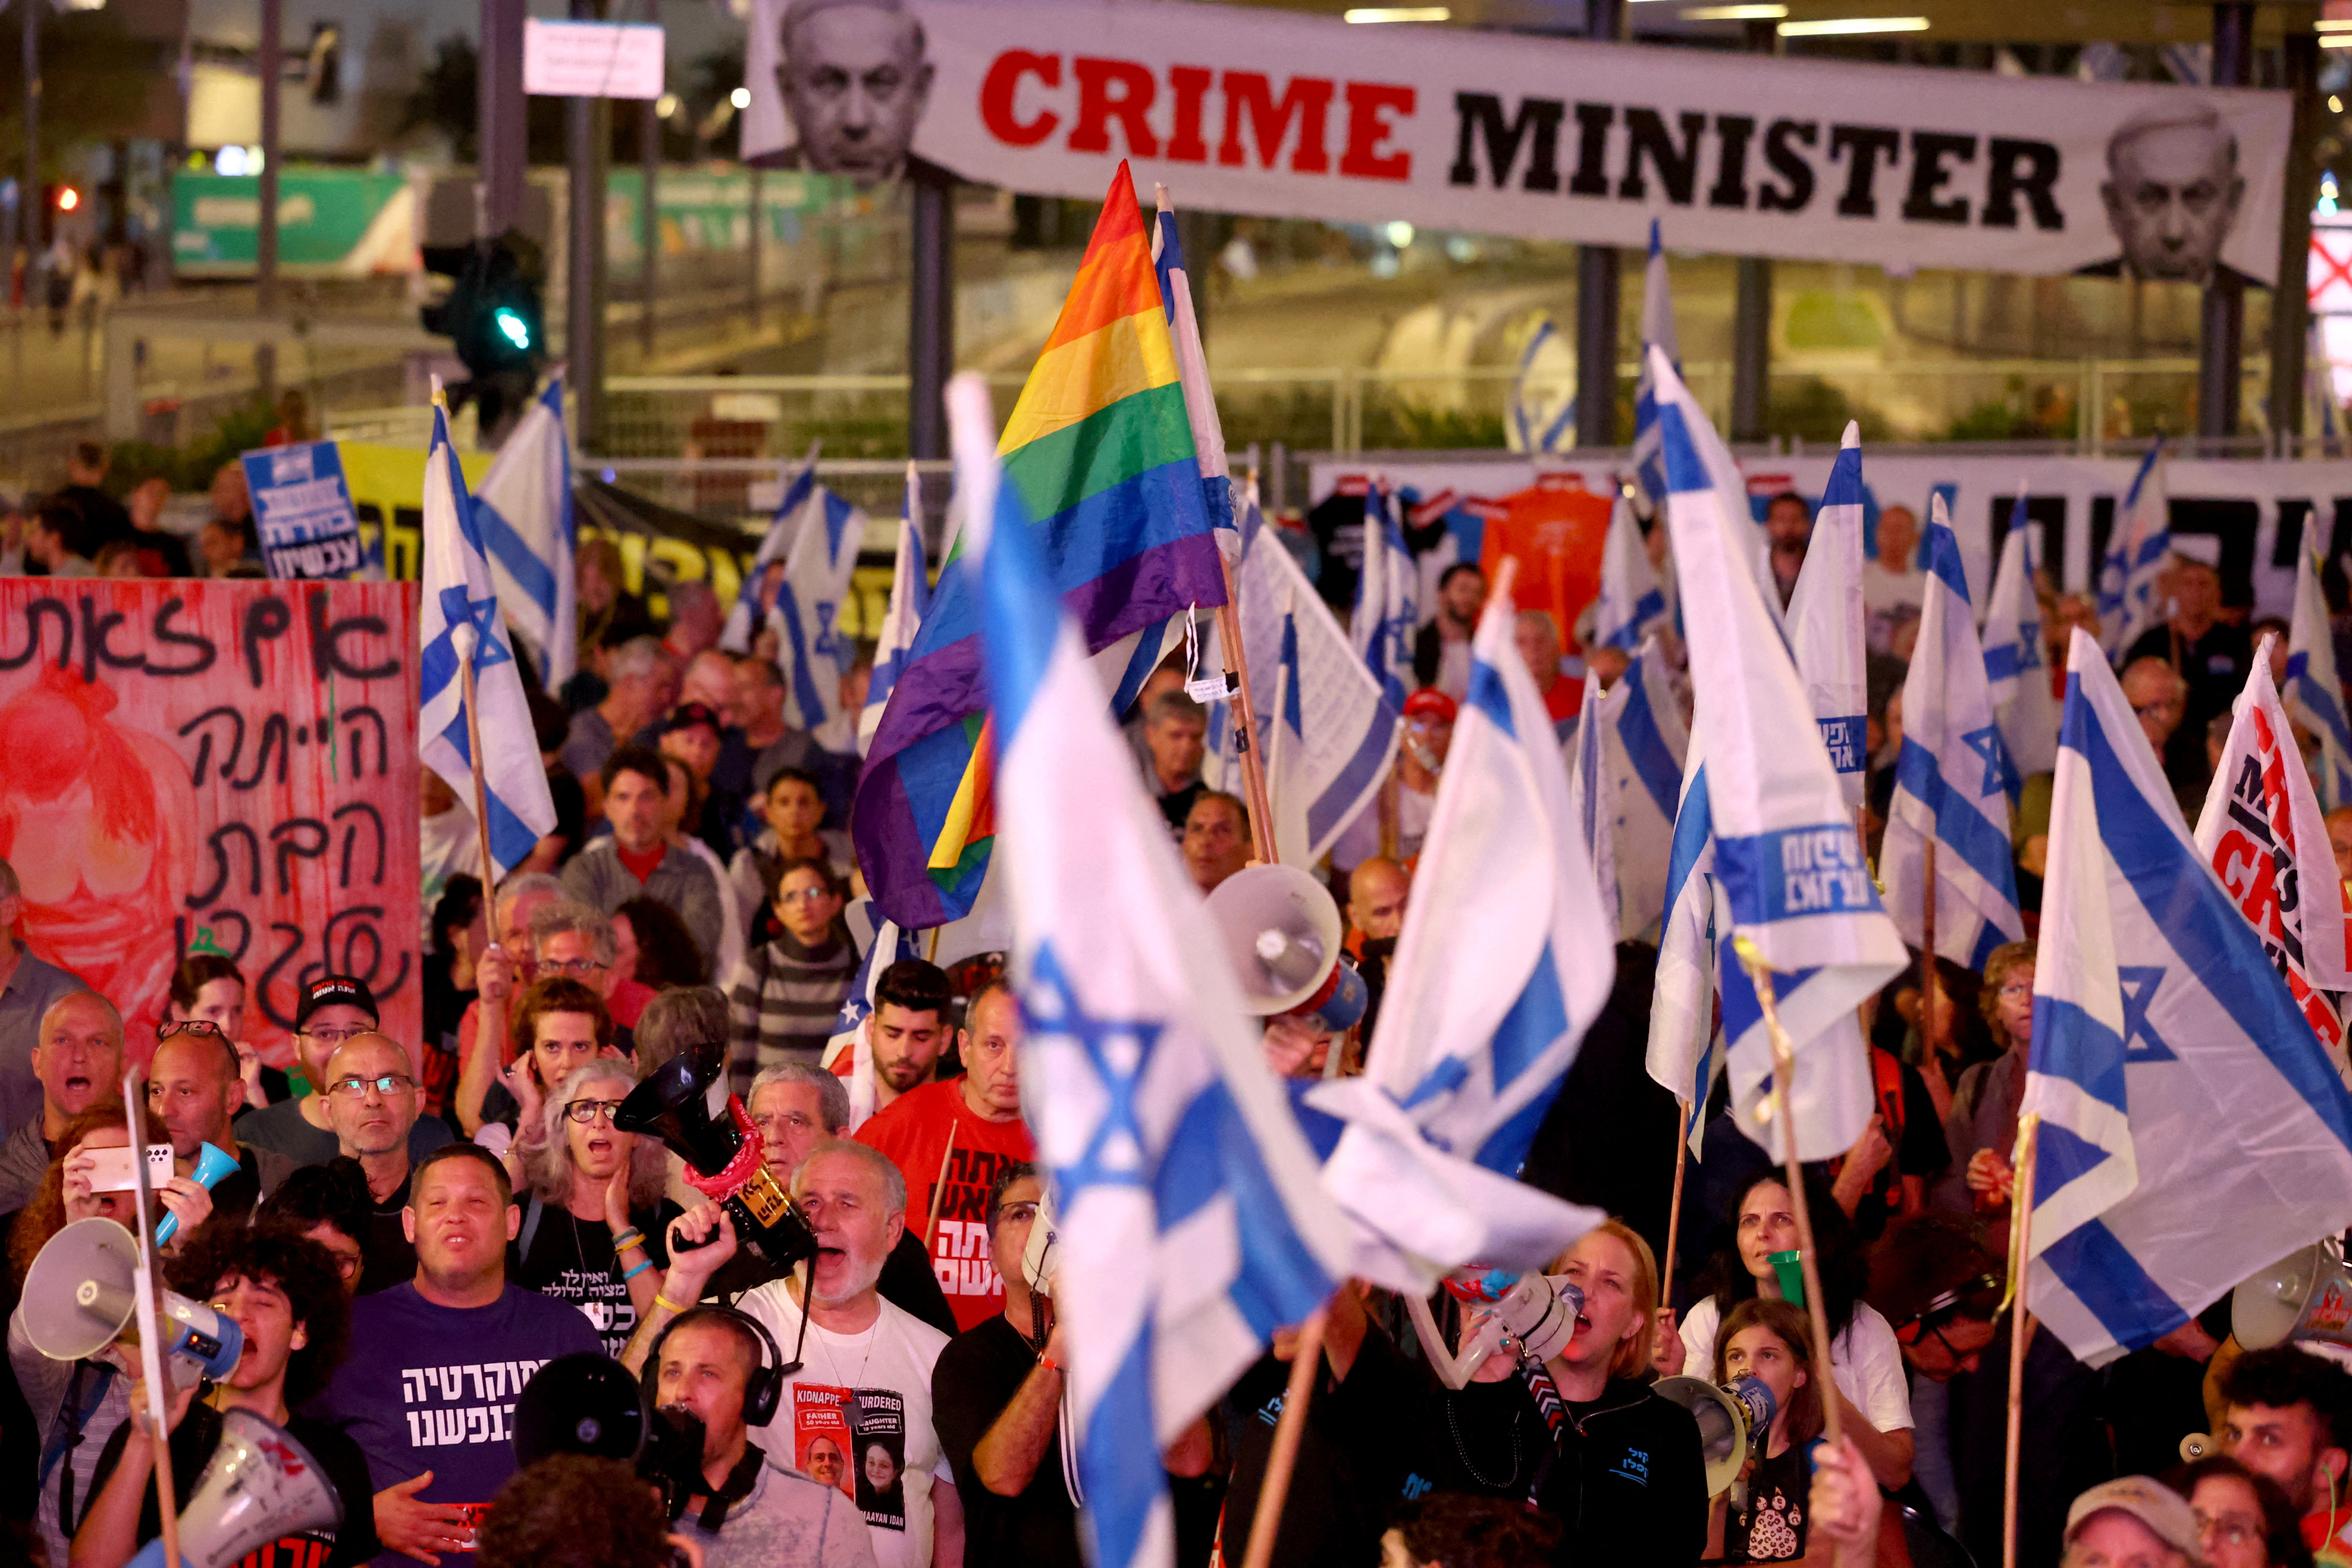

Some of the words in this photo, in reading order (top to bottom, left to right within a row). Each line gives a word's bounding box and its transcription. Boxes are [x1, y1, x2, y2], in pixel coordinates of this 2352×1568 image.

[979, 48, 1417, 182] CRIME
[1449, 90, 2064, 230] MINISTER
[938, 1220, 989, 1259] תה
[797, 1390, 842, 1407] KIDNAPPE
[858, 1395, 901, 1412] URDERED
[889, 1514, 904, 1527] IDAN
